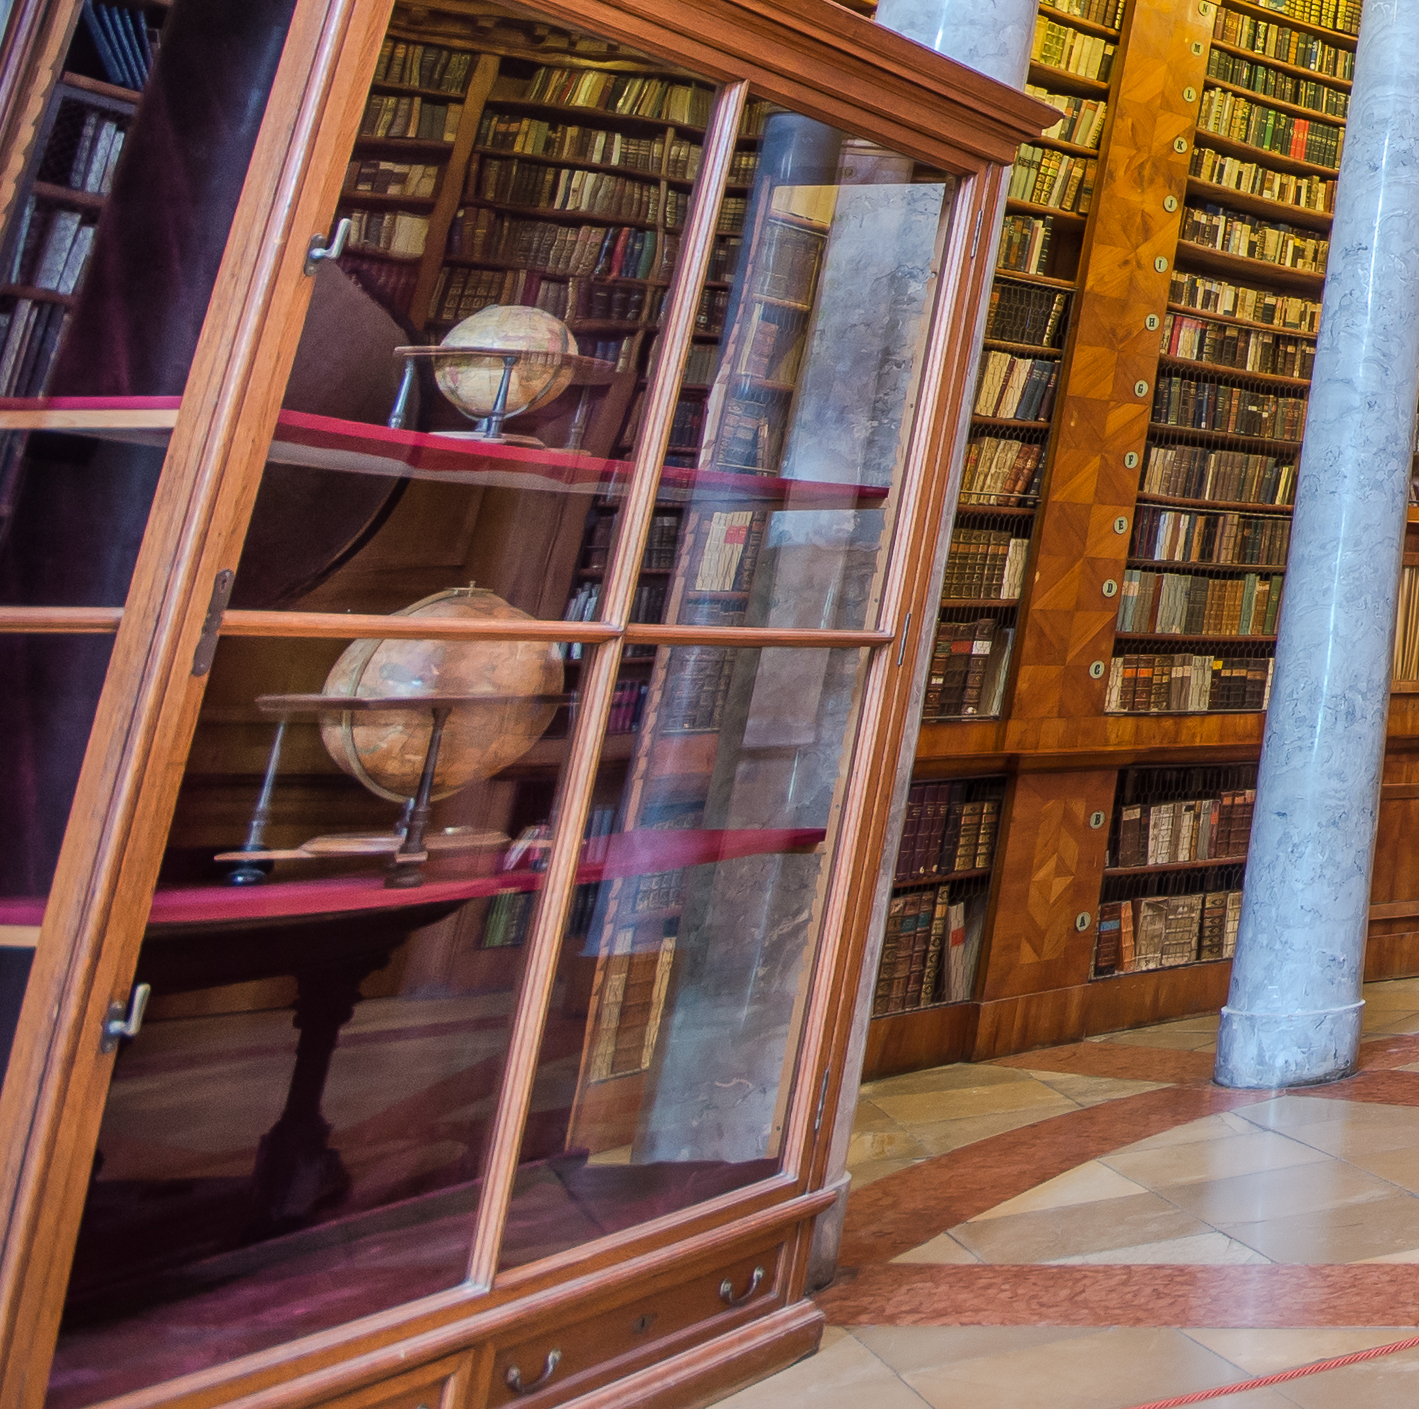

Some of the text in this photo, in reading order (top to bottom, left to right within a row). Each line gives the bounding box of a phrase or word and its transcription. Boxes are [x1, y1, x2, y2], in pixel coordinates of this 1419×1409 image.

[1187, 89, 1192, 99] L
[1177, 140, 1184, 150] K
[1168, 199, 1173, 209] J
[1158, 259, 1162, 269] I
[1148, 317, 1156, 327] H
[1128, 454, 1134, 465] F
[1118, 519, 1124, 530] E
[1107, 583, 1113, 594] D
[1094, 814, 1101, 826] B
[1079, 916, 1086, 928] A
